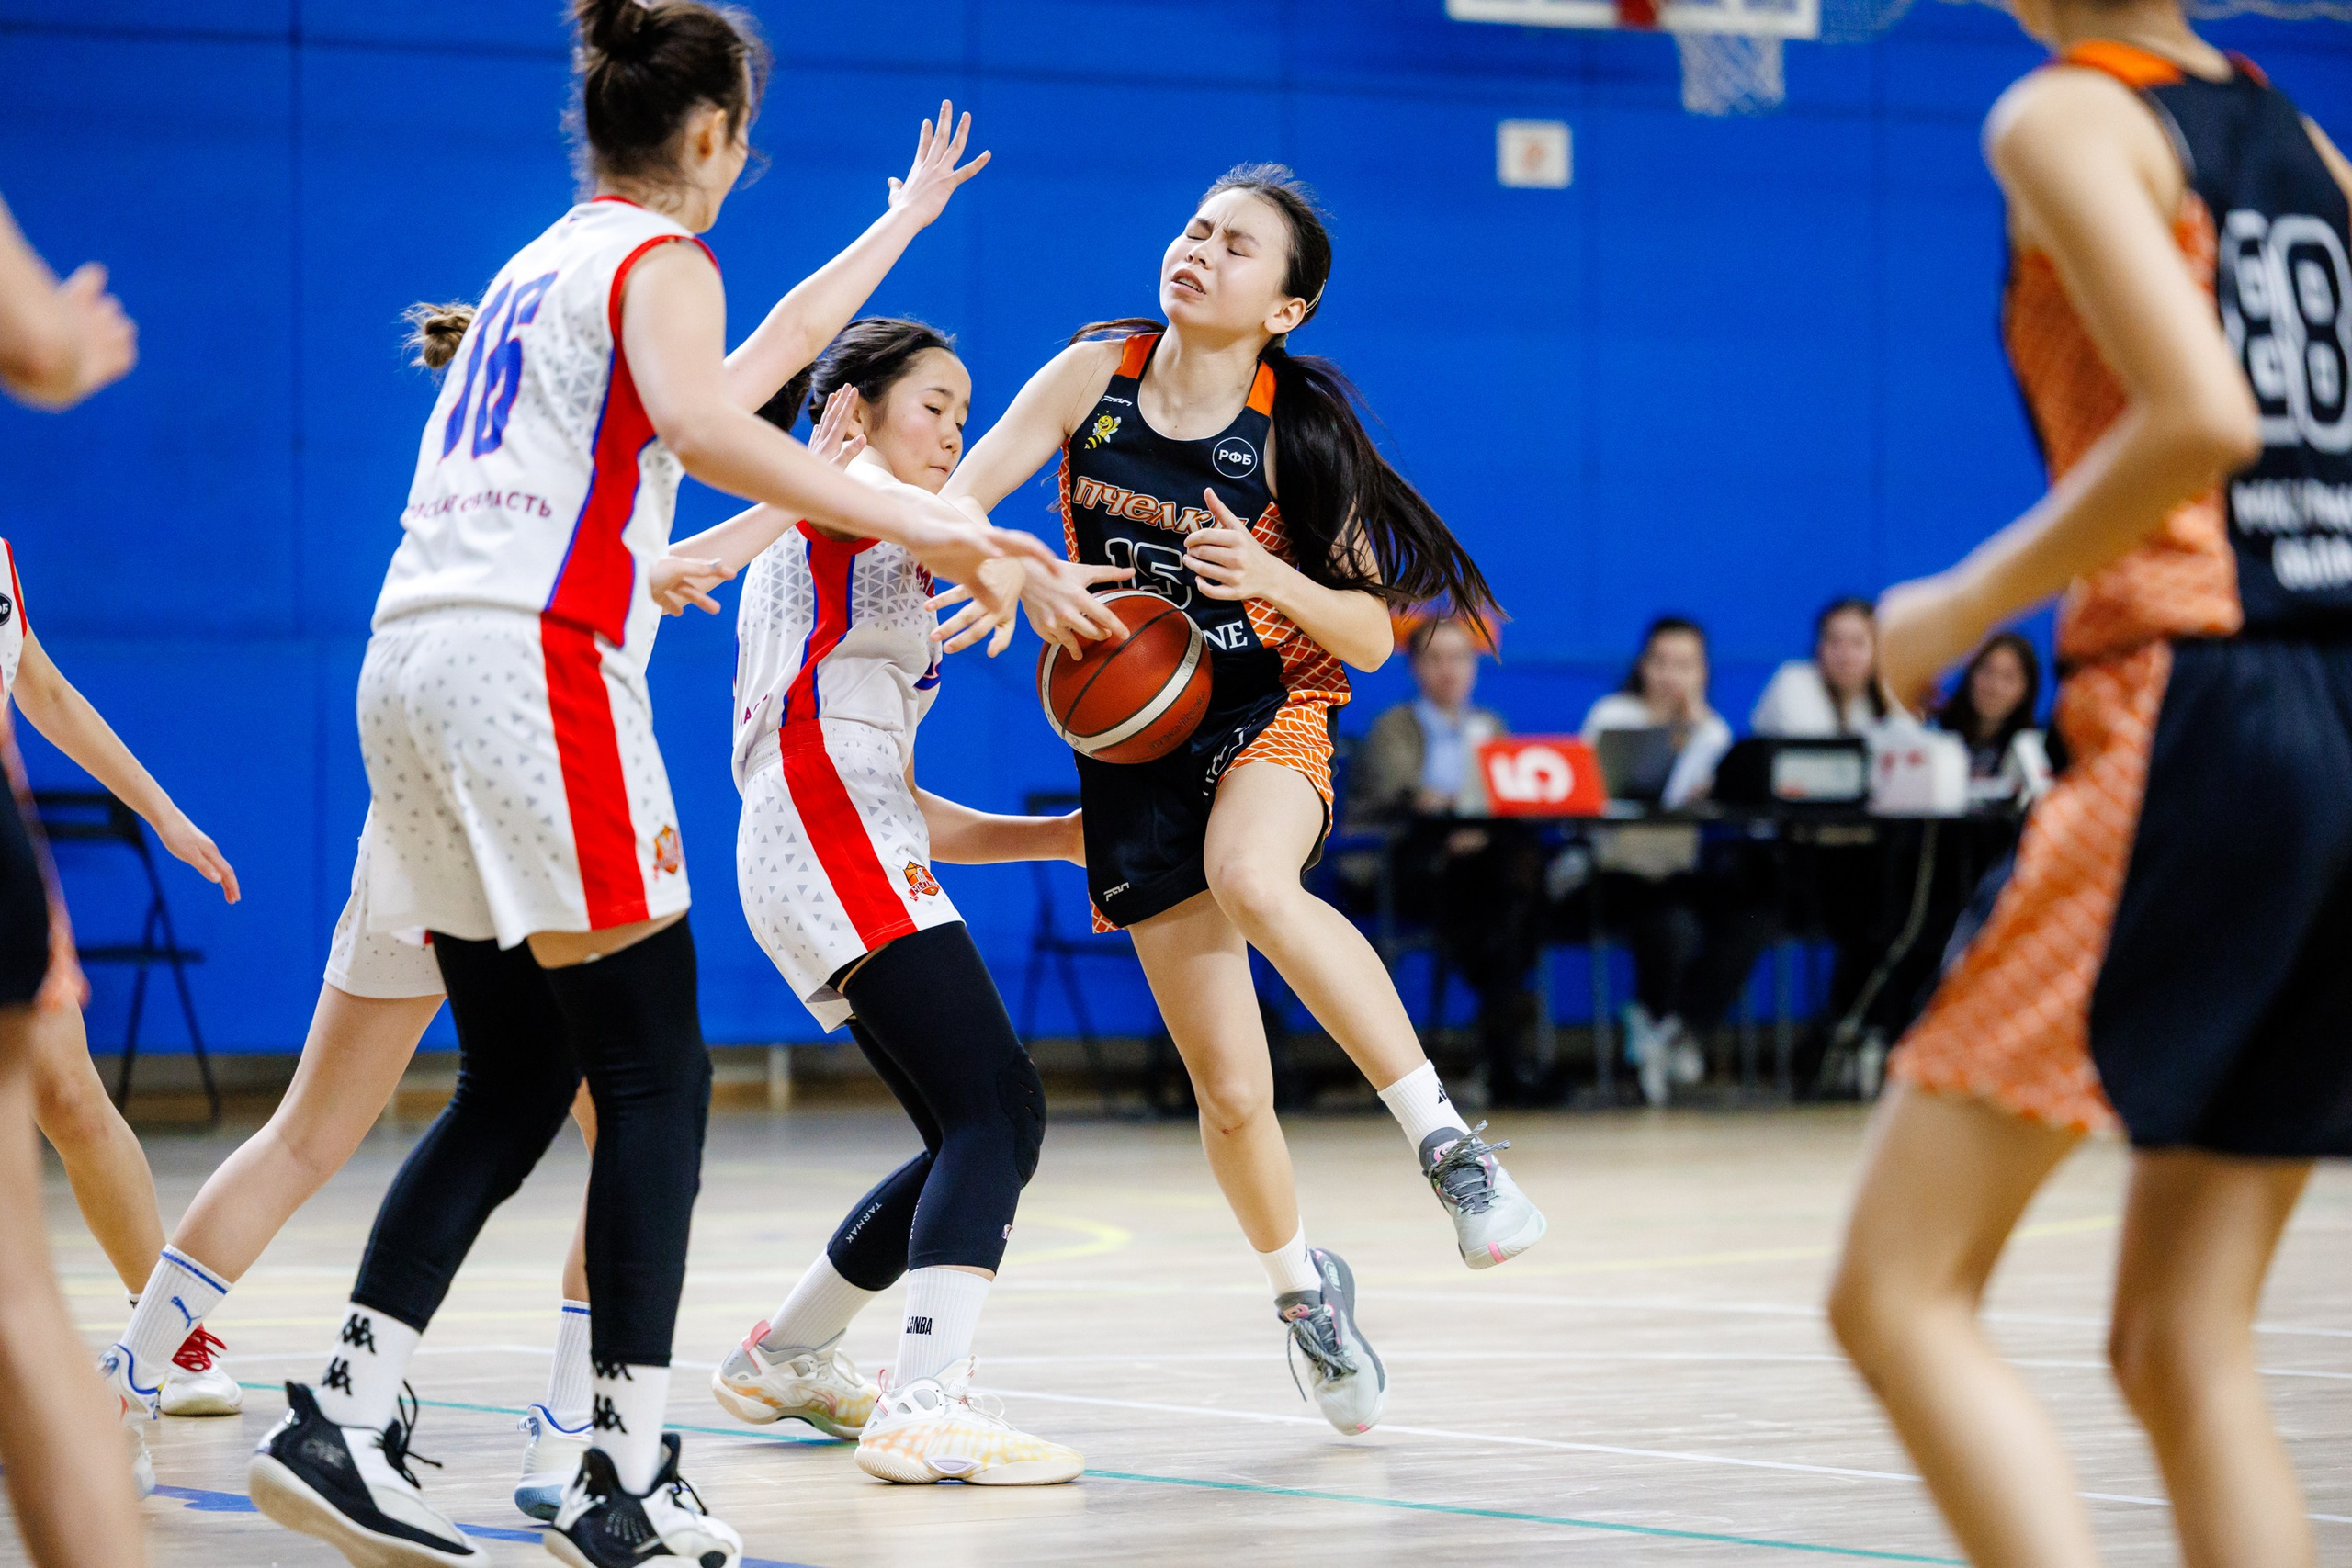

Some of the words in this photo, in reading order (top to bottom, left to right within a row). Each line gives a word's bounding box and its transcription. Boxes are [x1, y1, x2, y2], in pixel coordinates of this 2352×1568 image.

[1217, 449, 1252, 466] РФБ
[1104, 537, 1193, 611] 15
[1202, 620, 1249, 652] NE
[1487, 745, 1576, 805] 5
[845, 1201, 882, 1243] TARMAK
[912, 1315, 933, 1336] NBA
